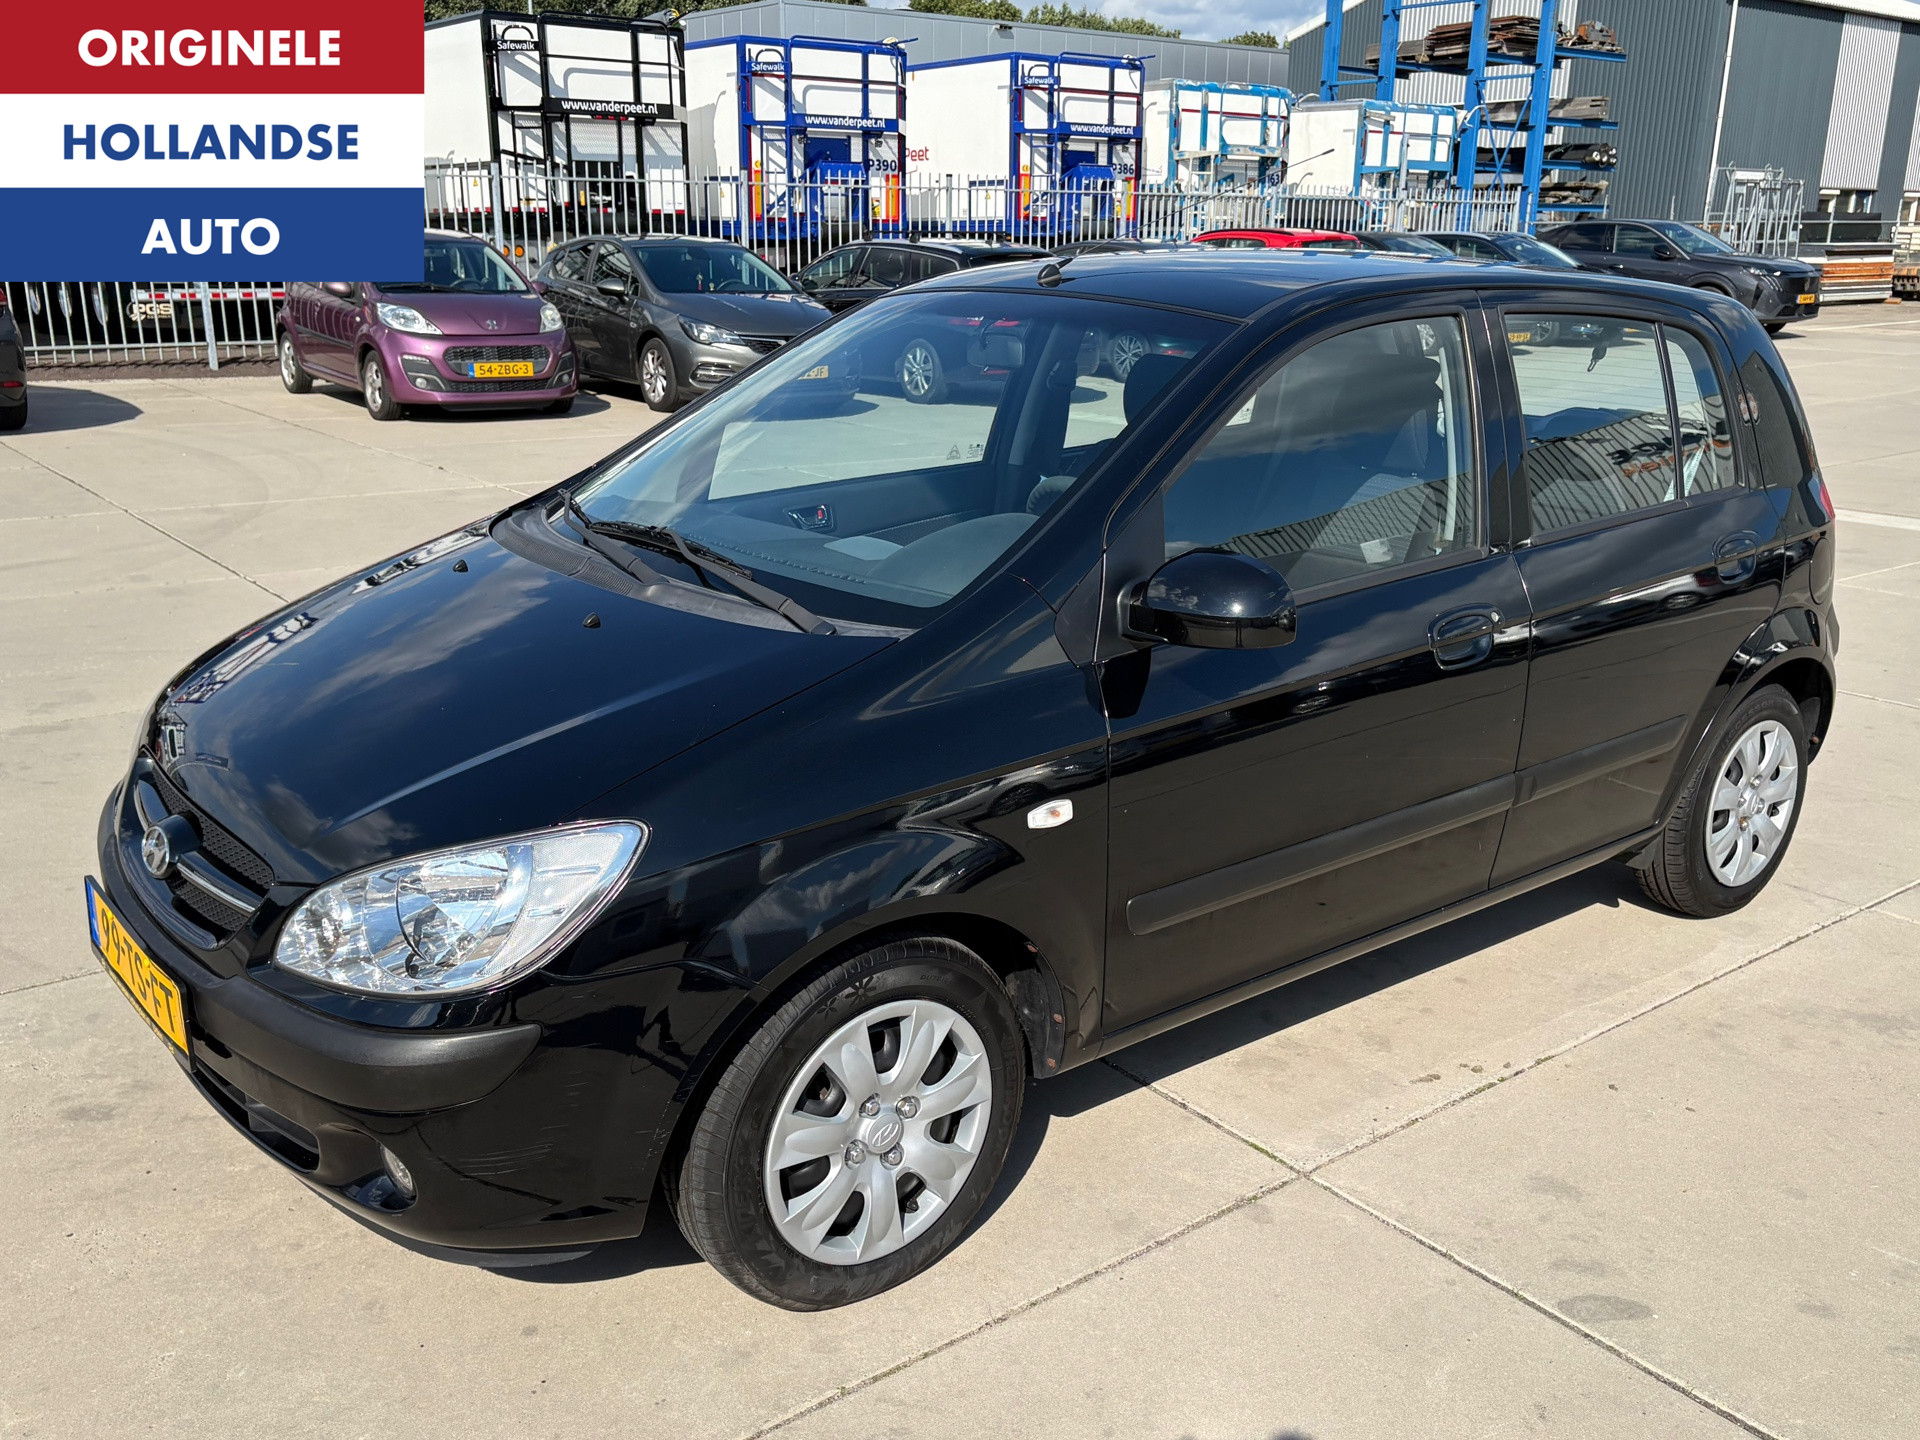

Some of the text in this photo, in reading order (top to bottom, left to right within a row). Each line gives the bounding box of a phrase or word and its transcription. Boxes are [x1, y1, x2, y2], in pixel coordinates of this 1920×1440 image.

[496, 40, 535, 50] Safewalk
[751, 62, 785, 71] Safewalk
[1024, 77, 1055, 85] Safewalk
[561, 100, 659, 115] www.vanderpeet.nl
[804, 115, 886, 129] www.vanderpeet.nl
[1070, 124, 1134, 136] www.vanderpeet.nl
[868, 158, 897, 172] P390
[479, 364, 530, 376] 54-ZBG-3
[101, 907, 176, 1034] 99-TS-FT
